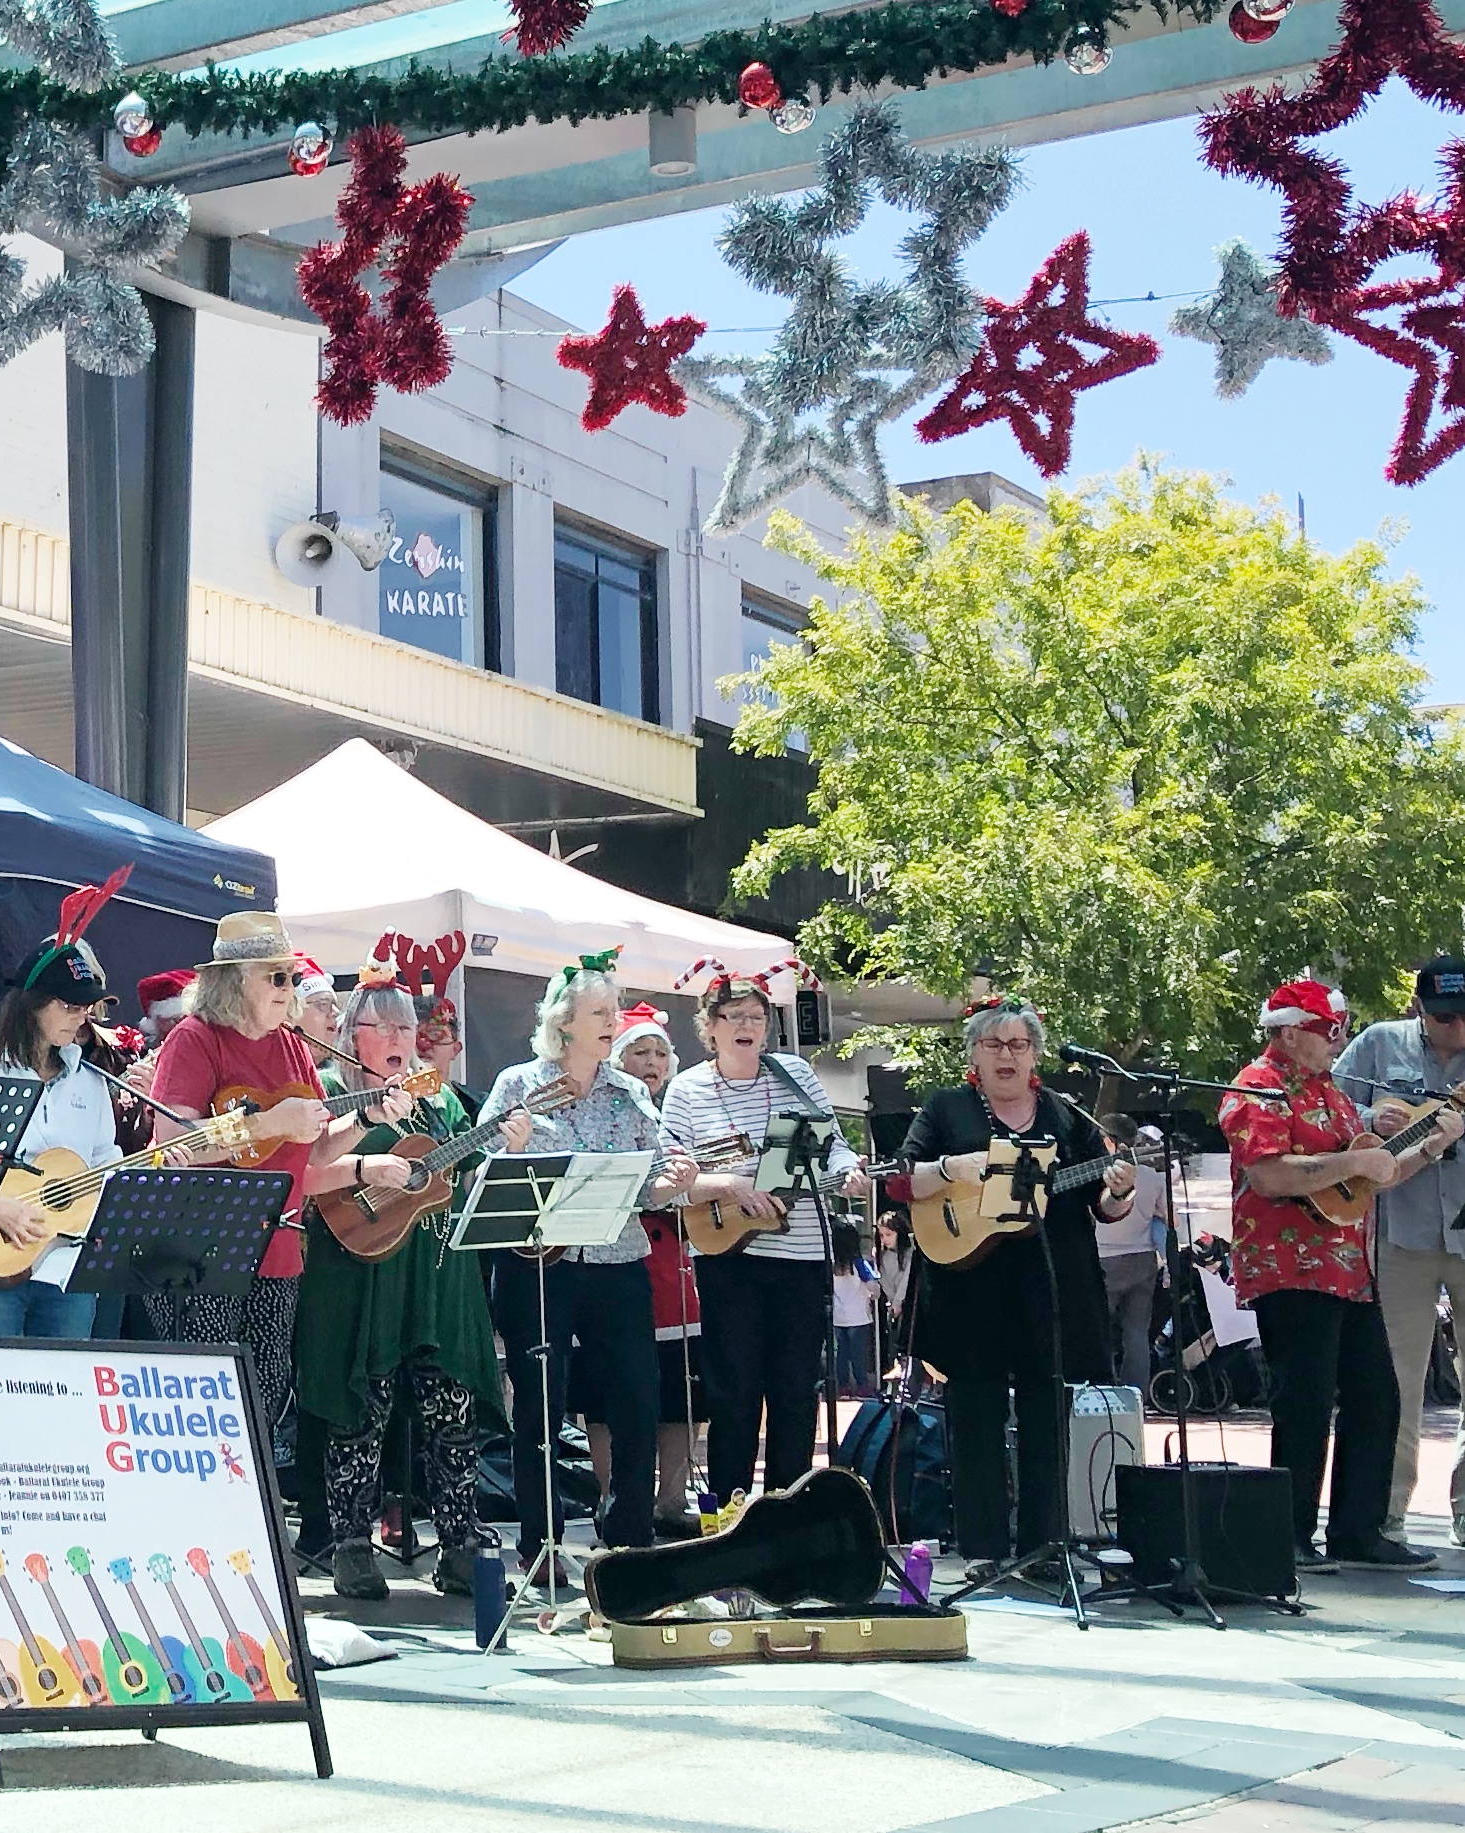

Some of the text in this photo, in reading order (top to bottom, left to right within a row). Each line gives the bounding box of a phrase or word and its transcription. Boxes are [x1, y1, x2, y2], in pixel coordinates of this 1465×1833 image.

[388, 536, 465, 573] Zenshin
[386, 589, 467, 617] KARATE
[6, 1379, 55, 1397] listening
[56, 1381, 68, 1395] to
[94, 1366, 235, 1400] Ballarat
[99, 1403, 240, 1437] Ukulele
[106, 1441, 216, 1482] Group
[18, 1476, 50, 1487] Ballarat
[81, 1478, 105, 1489] Group
[22, 1511, 43, 1521] Come
[45, 1511, 60, 1521] and
[62, 1511, 81, 1521] have
[90, 1512, 106, 1521] chat
